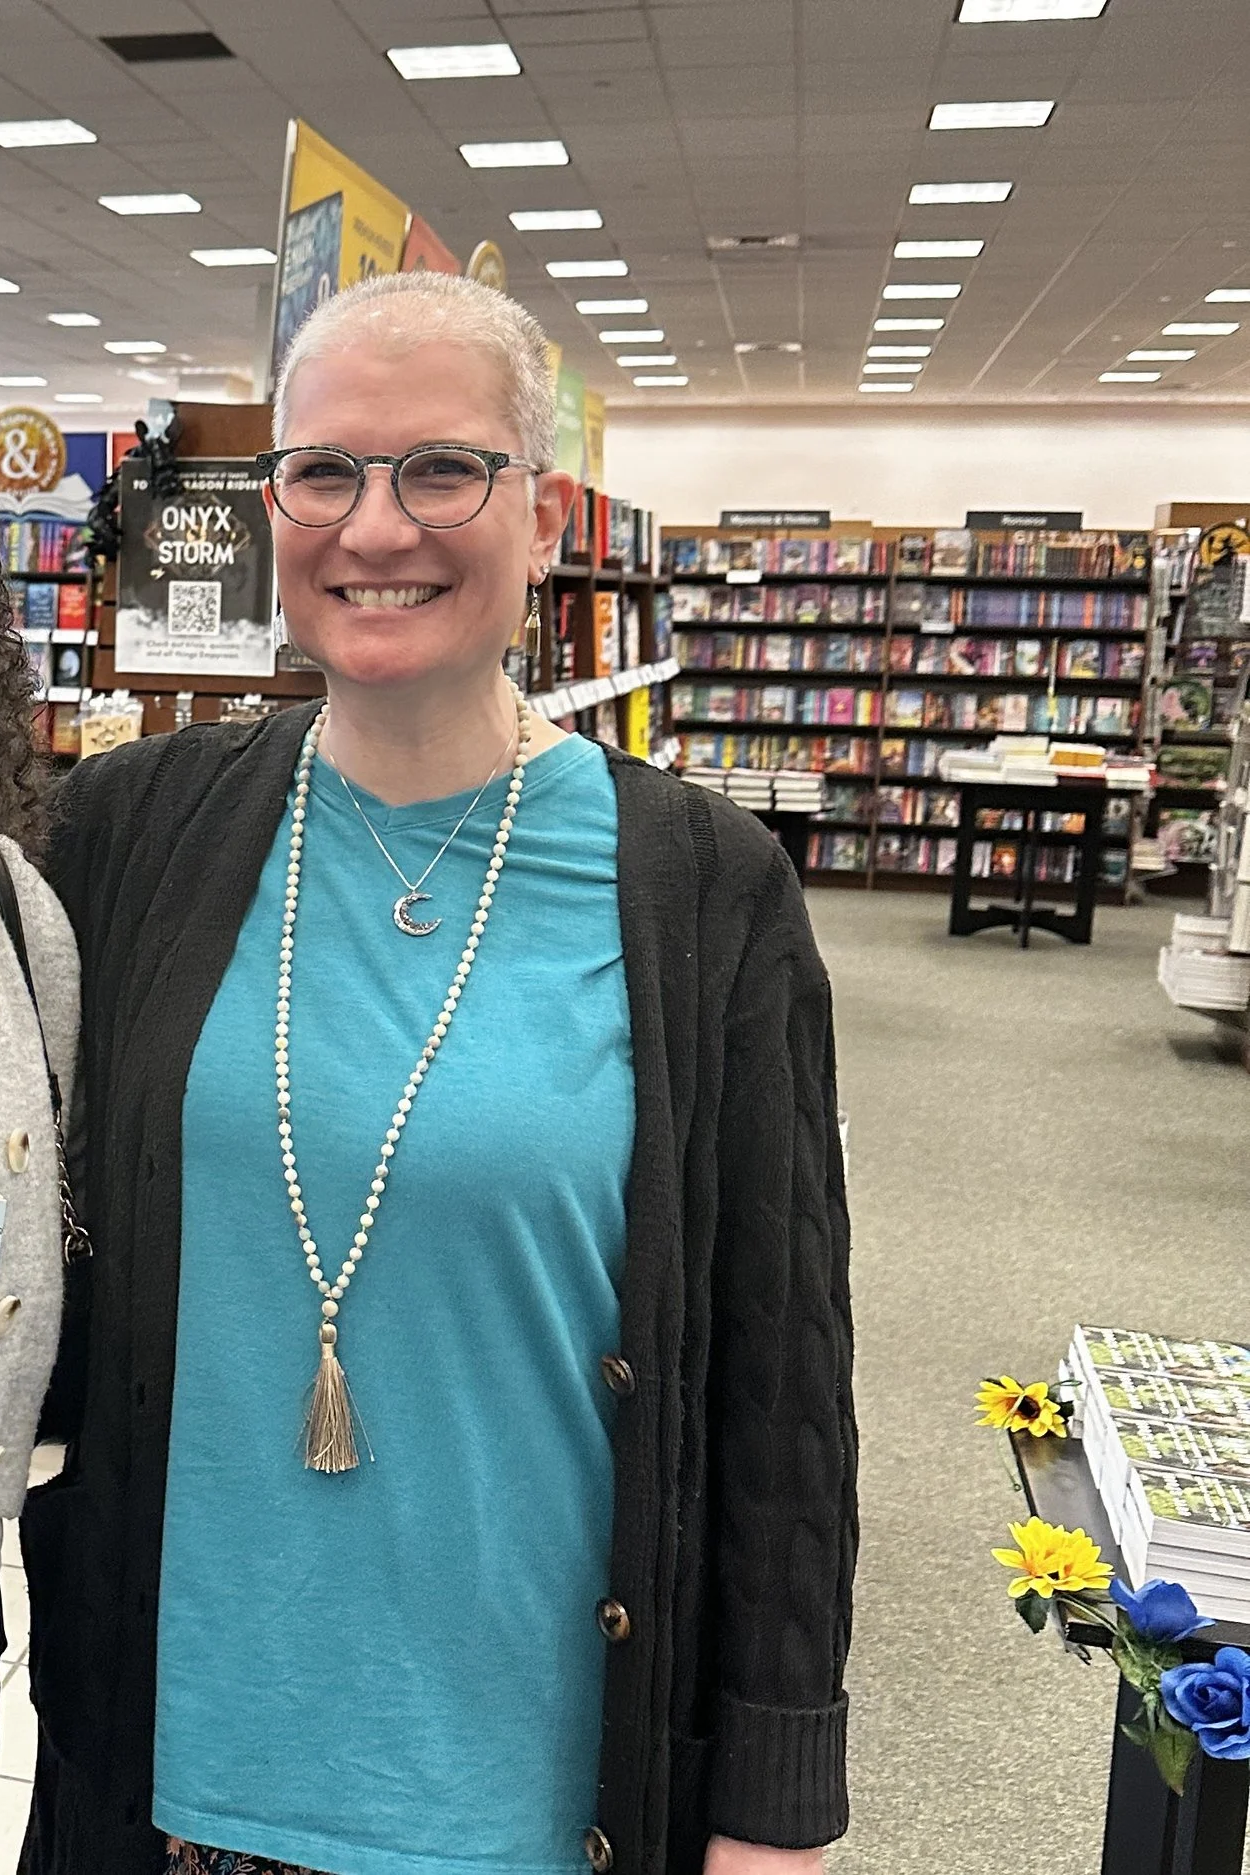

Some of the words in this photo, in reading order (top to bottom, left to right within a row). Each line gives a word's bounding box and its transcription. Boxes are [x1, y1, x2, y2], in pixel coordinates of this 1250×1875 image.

[1, 428, 41, 479] &
[133, 480, 148, 490] TO
[162, 506, 232, 532] ONYX
[158, 541, 235, 565] STORM
